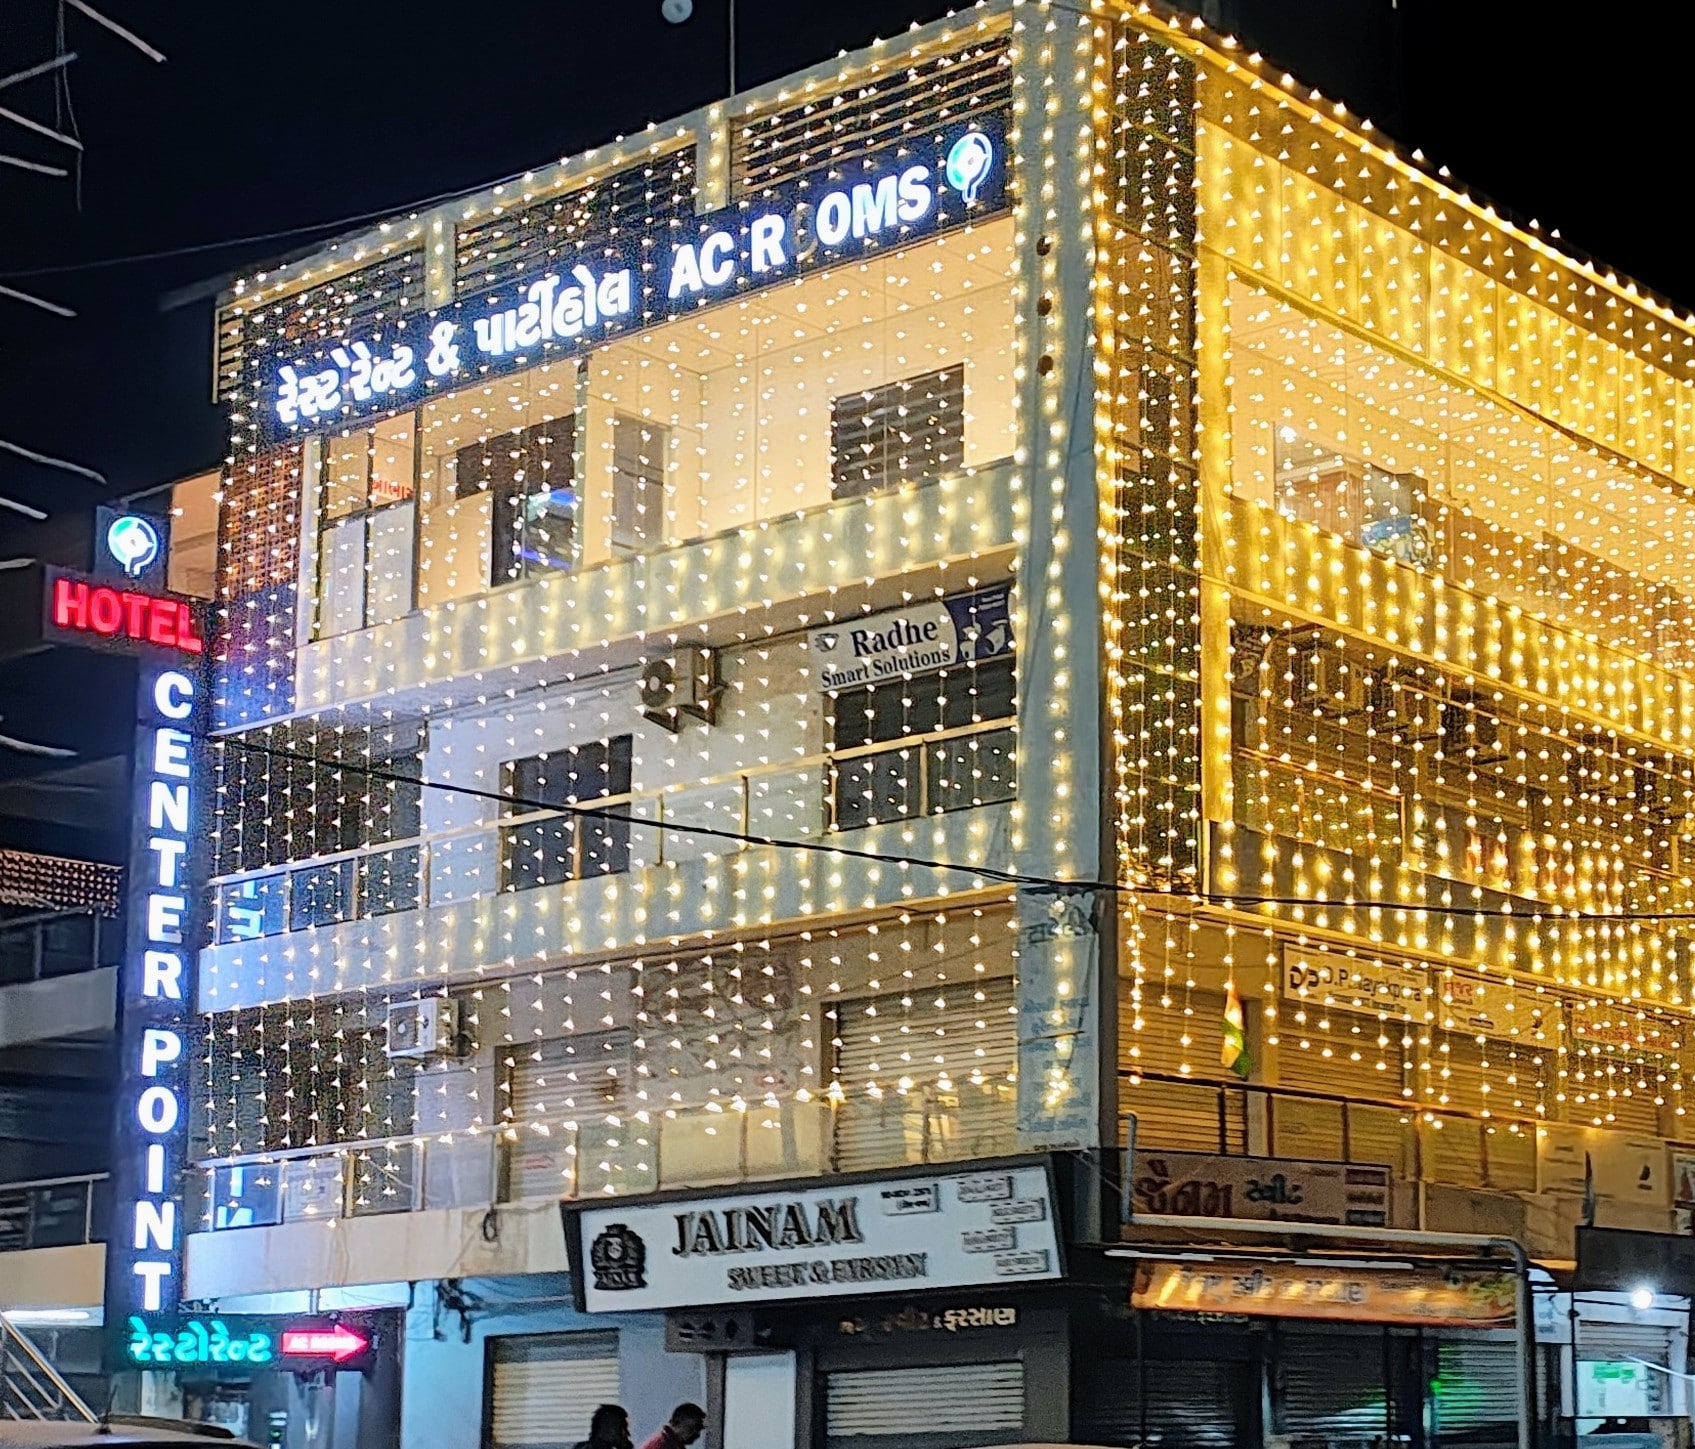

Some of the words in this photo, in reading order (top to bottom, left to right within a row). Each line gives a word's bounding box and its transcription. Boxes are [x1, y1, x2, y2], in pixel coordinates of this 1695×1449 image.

[668, 232, 735, 299] AC
[425, 320, 461, 376] &
[54, 578, 202, 653] HOTEL
[850, 620, 938, 658] Radhe
[821, 663, 869, 688] Smart
[873, 649, 951, 677] Solutions
[143, 671, 194, 999] CENTER
[133, 1028, 182, 1312] POINT
[672, 1197, 865, 1257] JAINAM
[727, 1261, 808, 1291] SWEET
